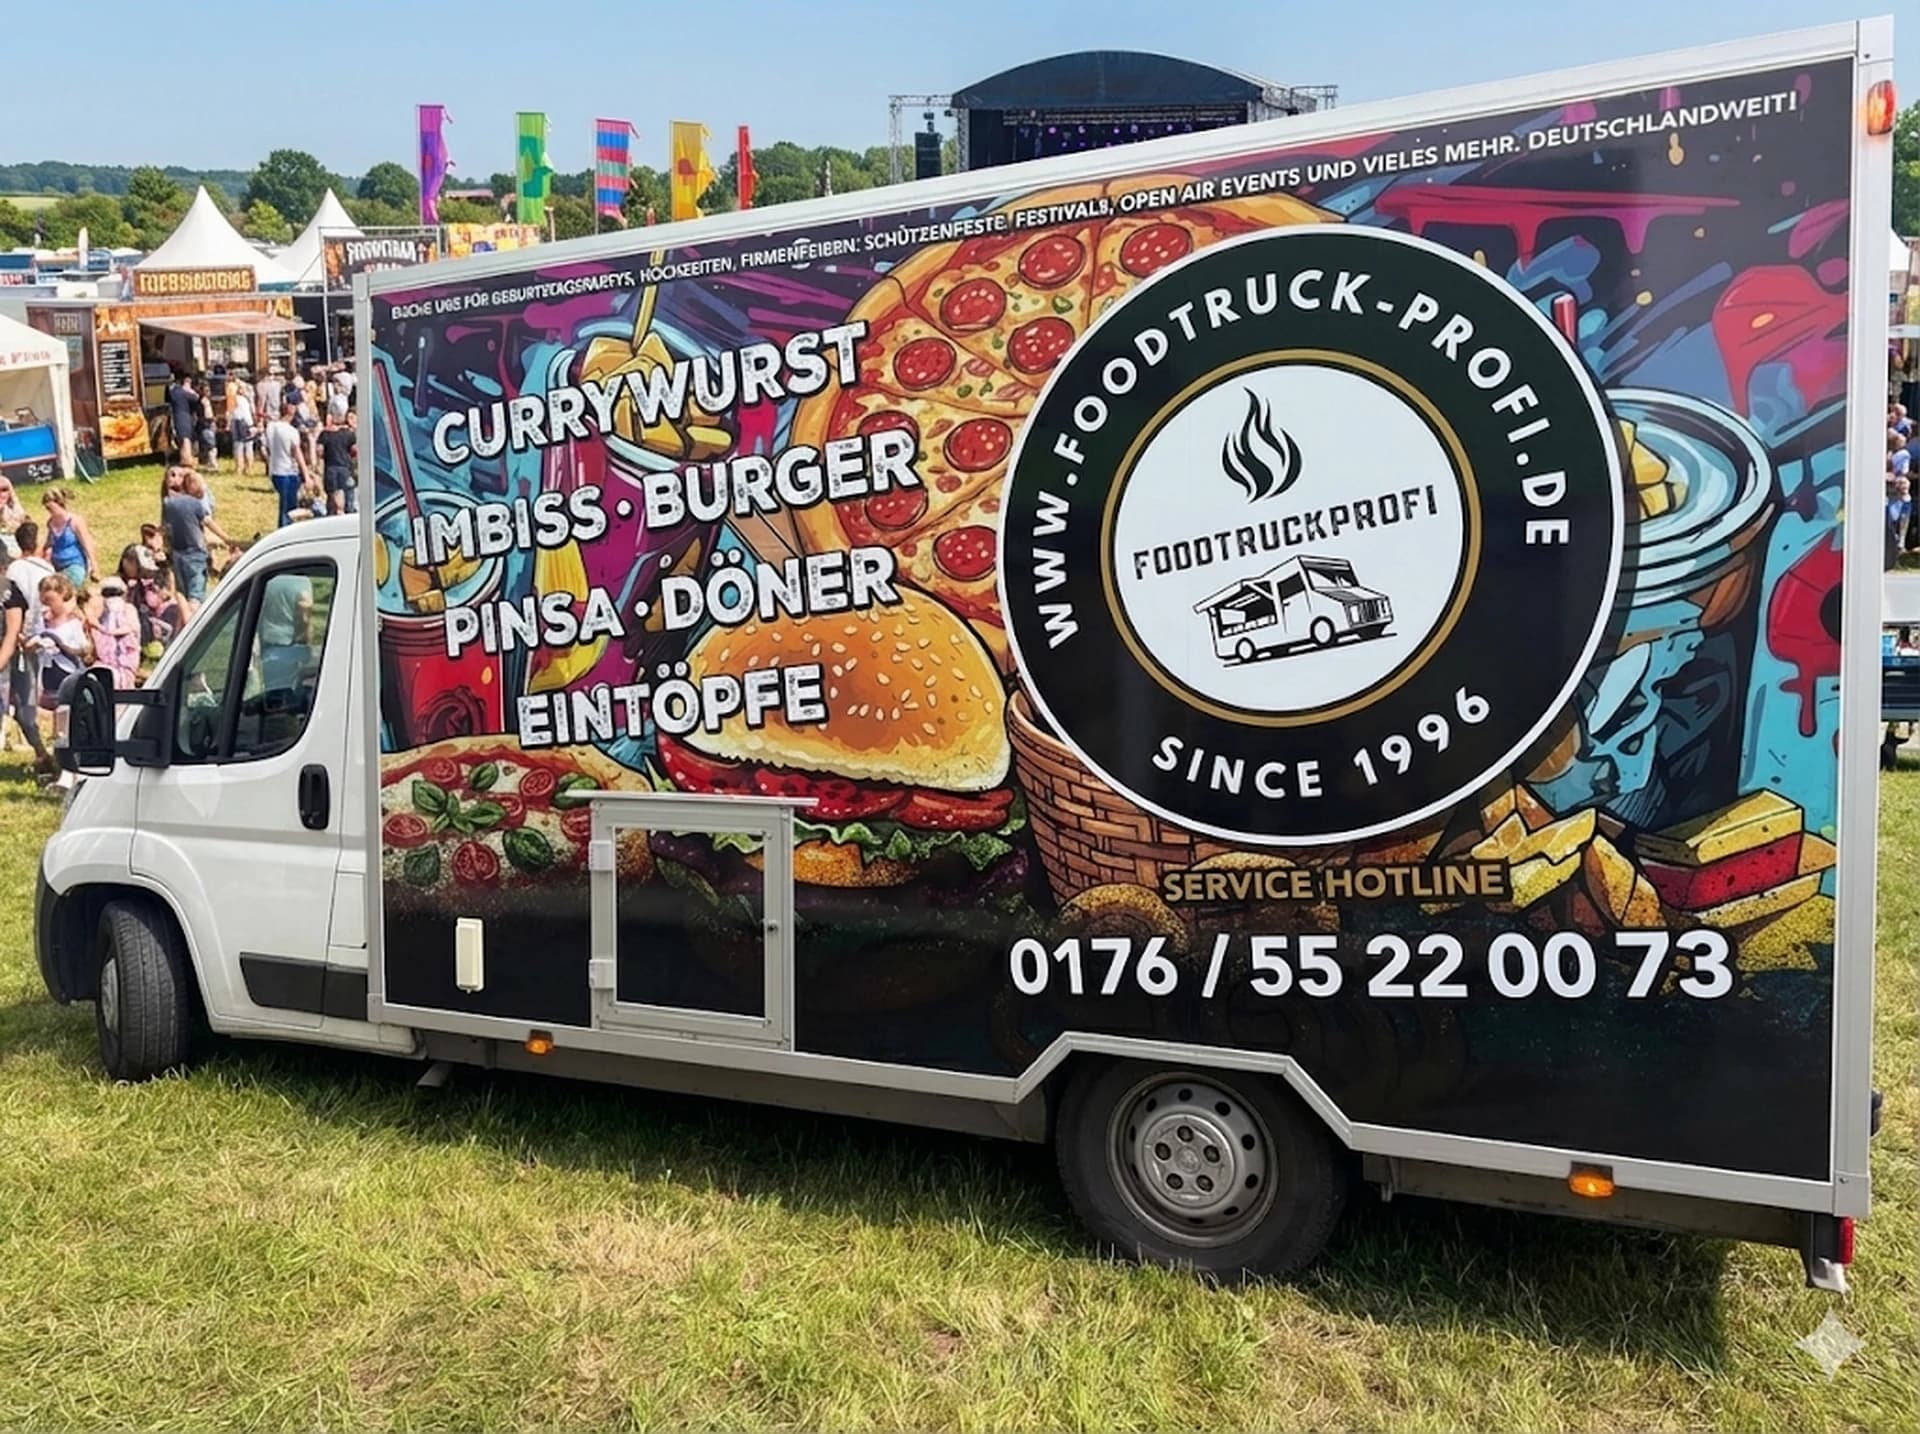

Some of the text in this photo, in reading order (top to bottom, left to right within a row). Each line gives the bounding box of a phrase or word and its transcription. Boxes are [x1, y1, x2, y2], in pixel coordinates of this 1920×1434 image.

[1120, 186, 1176, 213] OPEN
[1180, 179, 1215, 203] AIR
[1221, 167, 1300, 197] EVENTS
[1307, 159, 1357, 183] UND
[1363, 147, 1438, 175] VIELES
[1445, 132, 1521, 163] MEHR.
[433, 321, 868, 463] CURRYWURST
[412, 484, 607, 566] IMBISS
[643, 430, 920, 529] BURGER
[1032, 269, 1569, 649] WWW.FOODTRUCK-PROFI.DE
[1133, 484, 1439, 580] FOODTRUCKPROFI
[445, 587, 625, 657] PINSA
[661, 546, 898, 630] DÖNER
[517, 660, 827, 747] EINTÖPFE
[1151, 686, 1492, 799] SINCE 1996
[1163, 863, 1504, 902] SERVICE HOTLINE
[1009, 935, 1180, 997] 0176
[1250, 934, 1344, 997] 55
[1366, 933, 1469, 998] 22
[1487, 932, 1597, 999] 00
[1615, 930, 1735, 1000] 73
